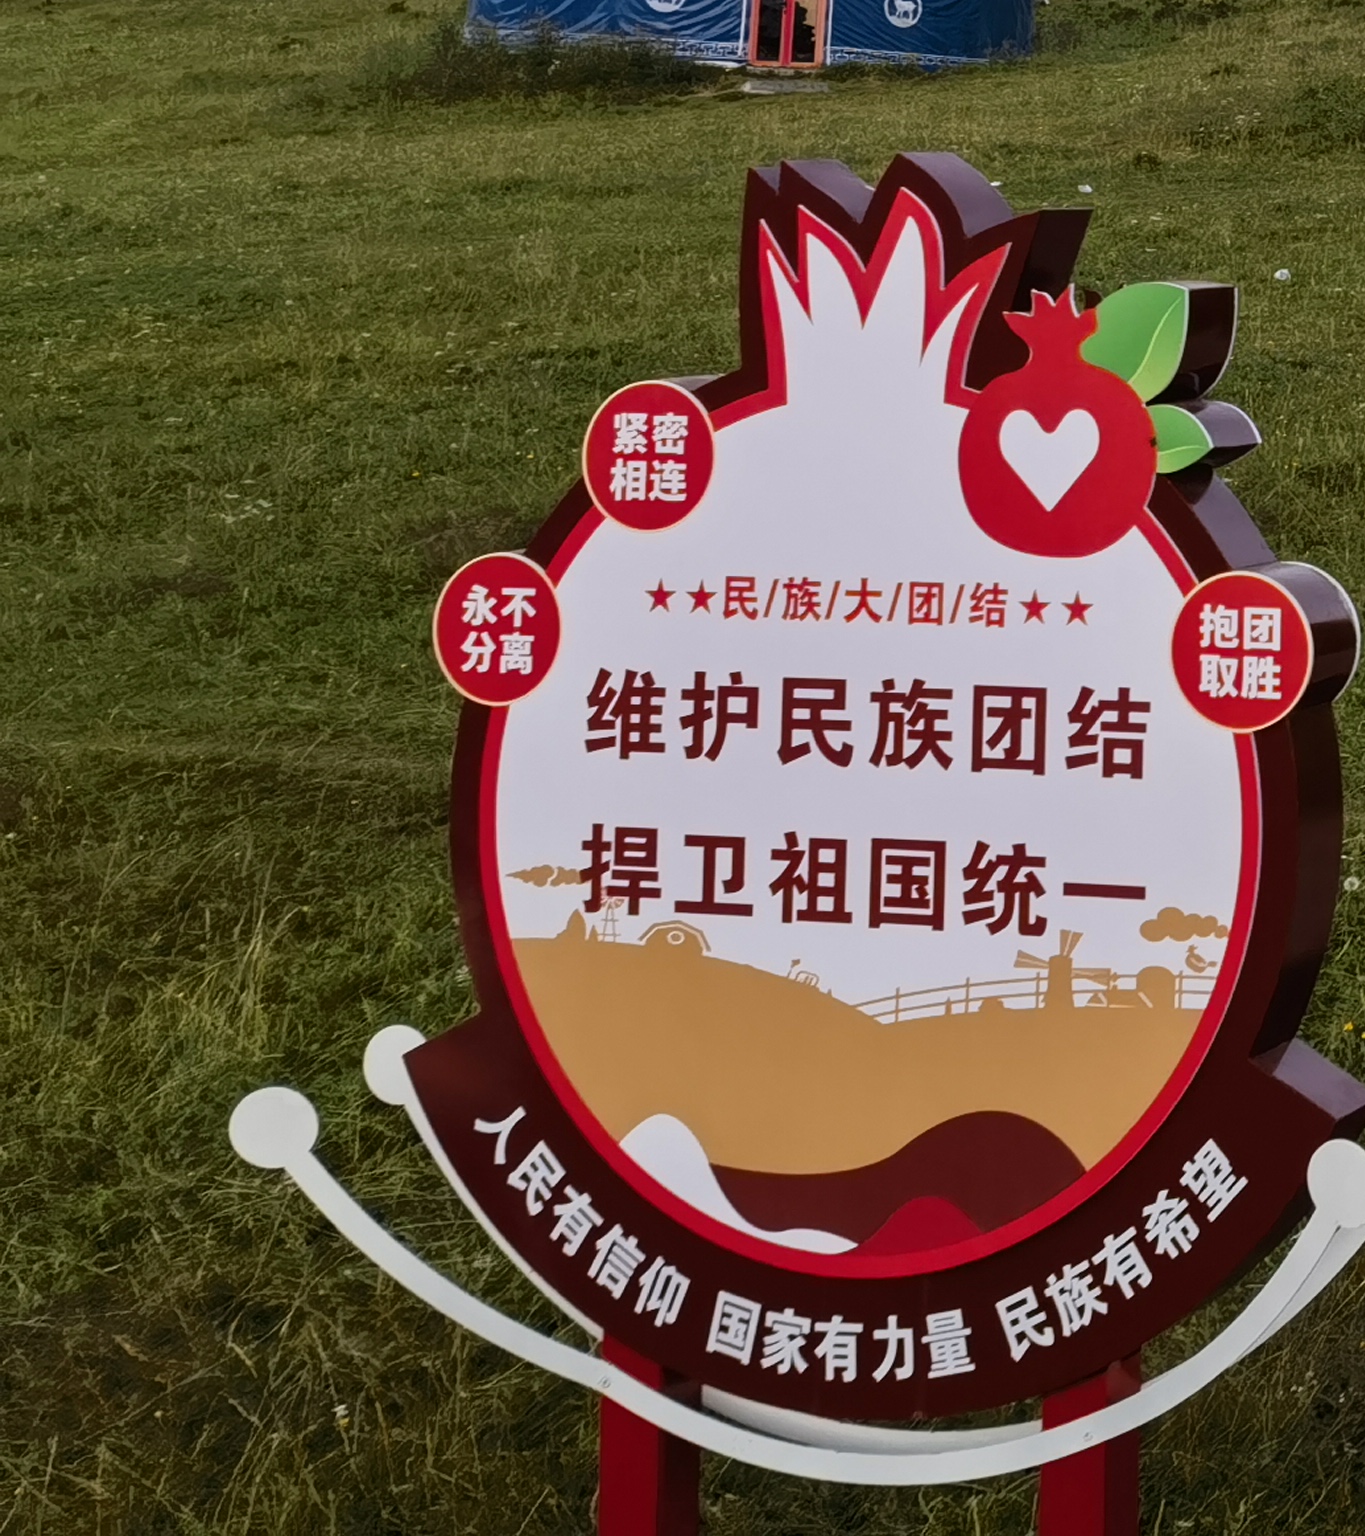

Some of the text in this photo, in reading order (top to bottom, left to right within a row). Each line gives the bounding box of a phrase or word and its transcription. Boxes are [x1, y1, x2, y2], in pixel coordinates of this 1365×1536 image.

[611, 412, 689, 455] 紧密
[610, 458, 688, 501] 相连
[461, 584, 537, 628] 永不
[1198, 603, 1282, 651] 抱团
[460, 631, 536, 675] 分离
[1198, 654, 1282, 700] 取胜
[584, 667, 1152, 780] 维护民族团结
[579, 822, 1147, 937] 捍卫祖国统一
[472, 1106, 1249, 1384] 人民有信仰 国家有力量 民族有希望
